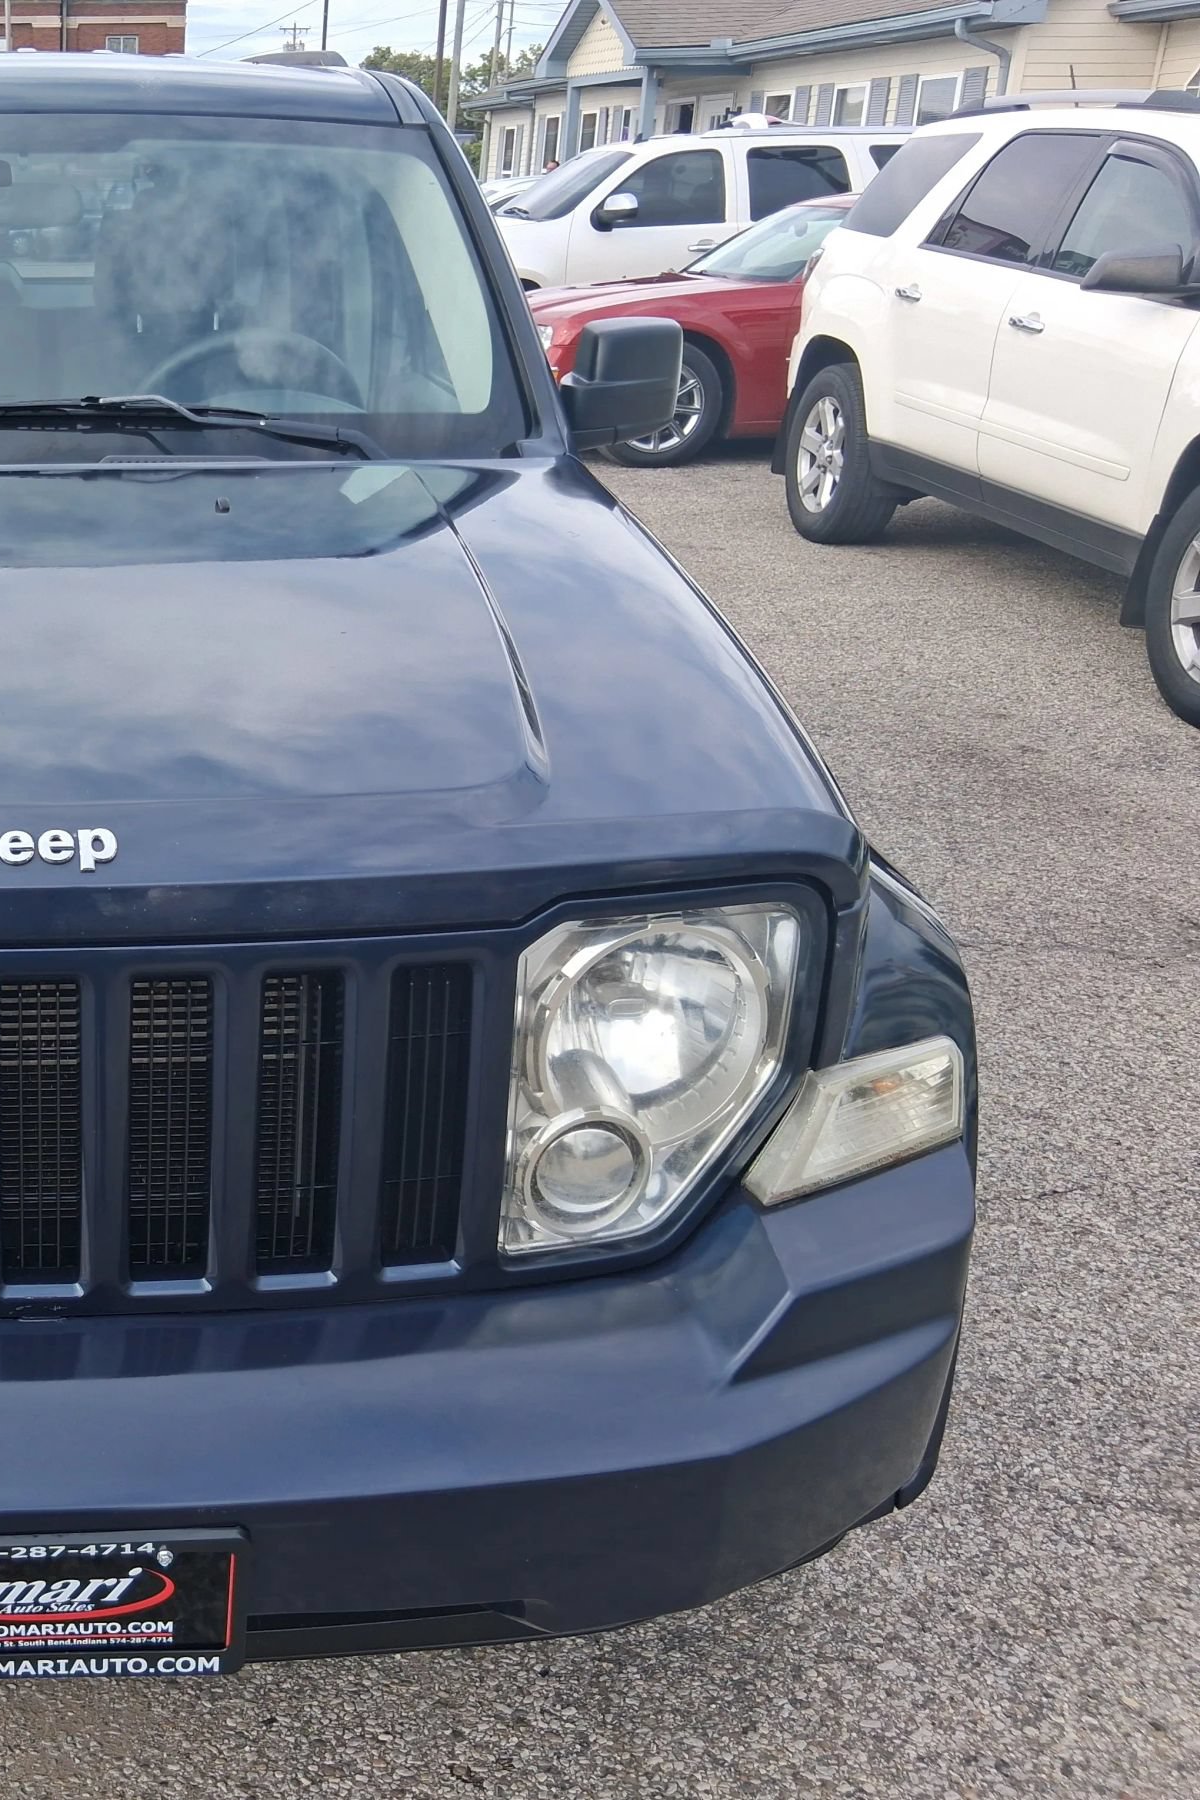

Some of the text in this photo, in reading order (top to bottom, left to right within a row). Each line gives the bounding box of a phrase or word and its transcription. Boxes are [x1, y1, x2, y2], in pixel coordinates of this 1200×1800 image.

[46, 1601, 95, 1613] Sales
[3, 1640, 17, 1648] St.
[18, 1639, 46, 1647] South
[110, 1636, 173, 1645] 574-287-4714
